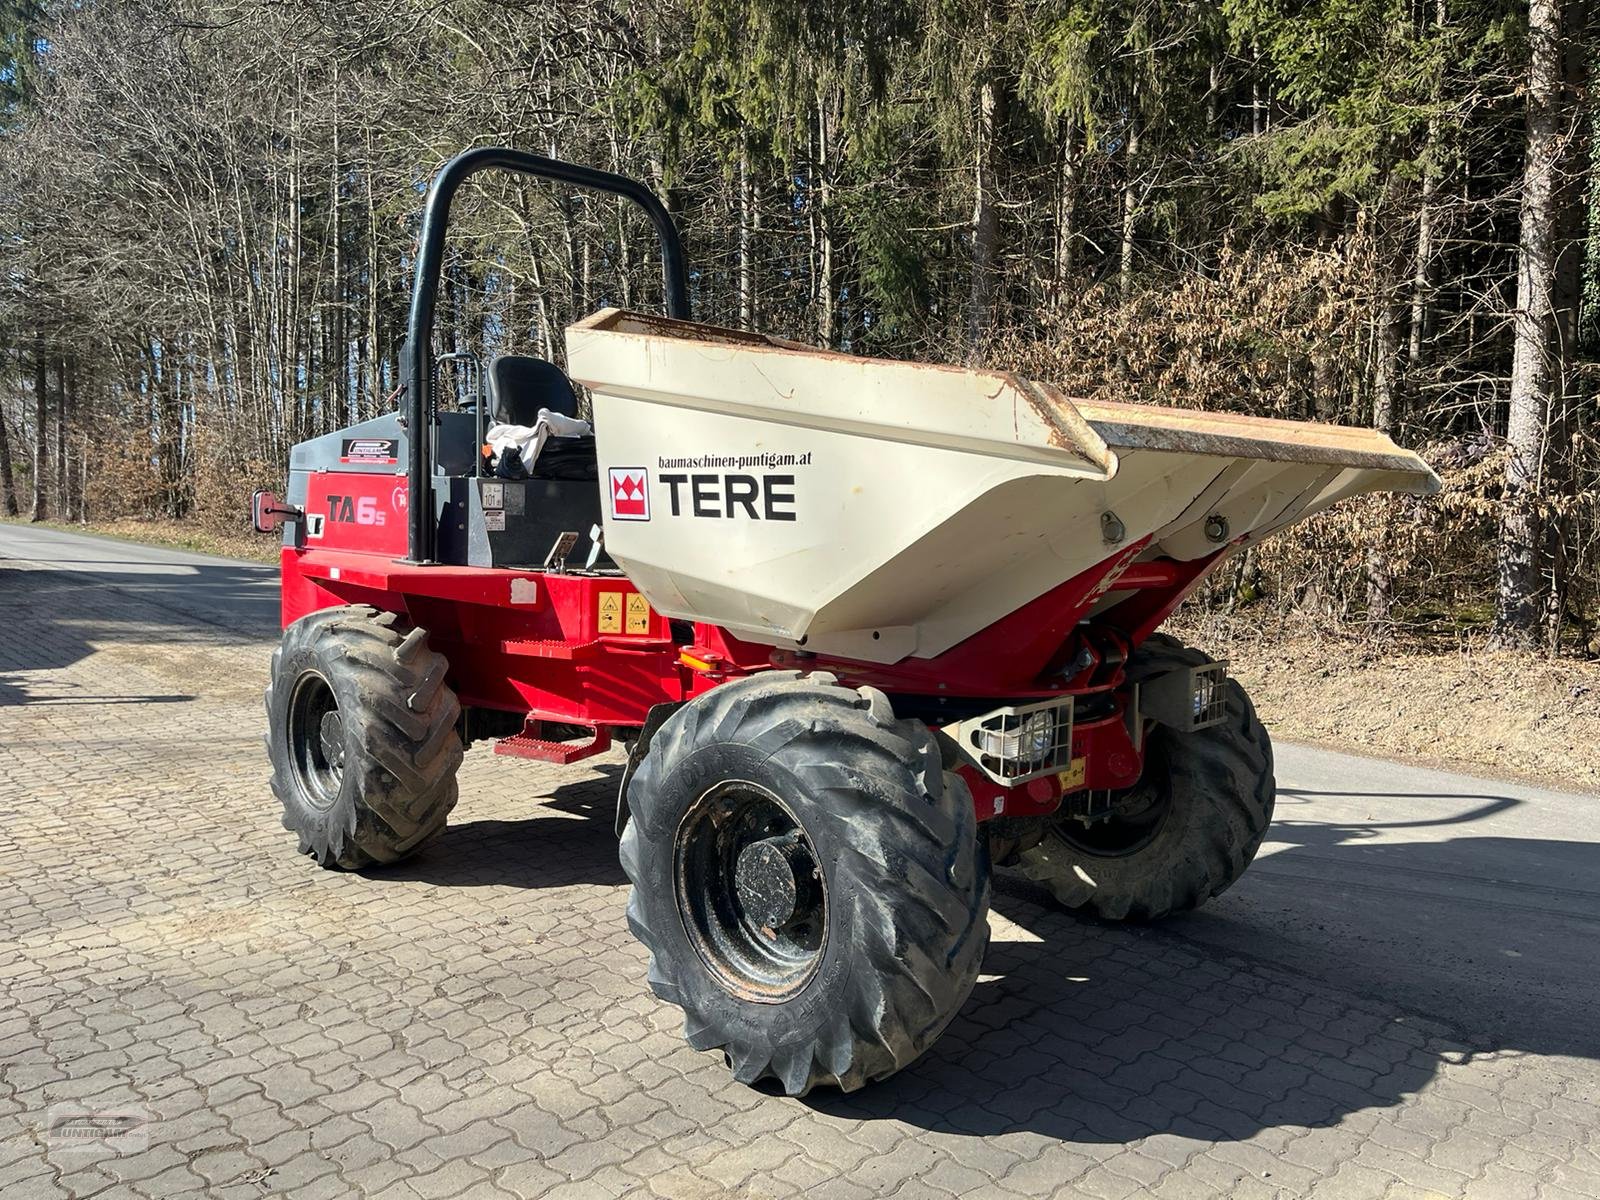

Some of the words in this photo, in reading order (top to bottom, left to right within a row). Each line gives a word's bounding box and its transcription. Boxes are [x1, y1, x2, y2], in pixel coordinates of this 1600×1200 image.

[658, 452, 812, 470] baumaschinen-puntigam.at
[484, 494, 496, 506] 101
[658, 474, 797, 521] TERE
